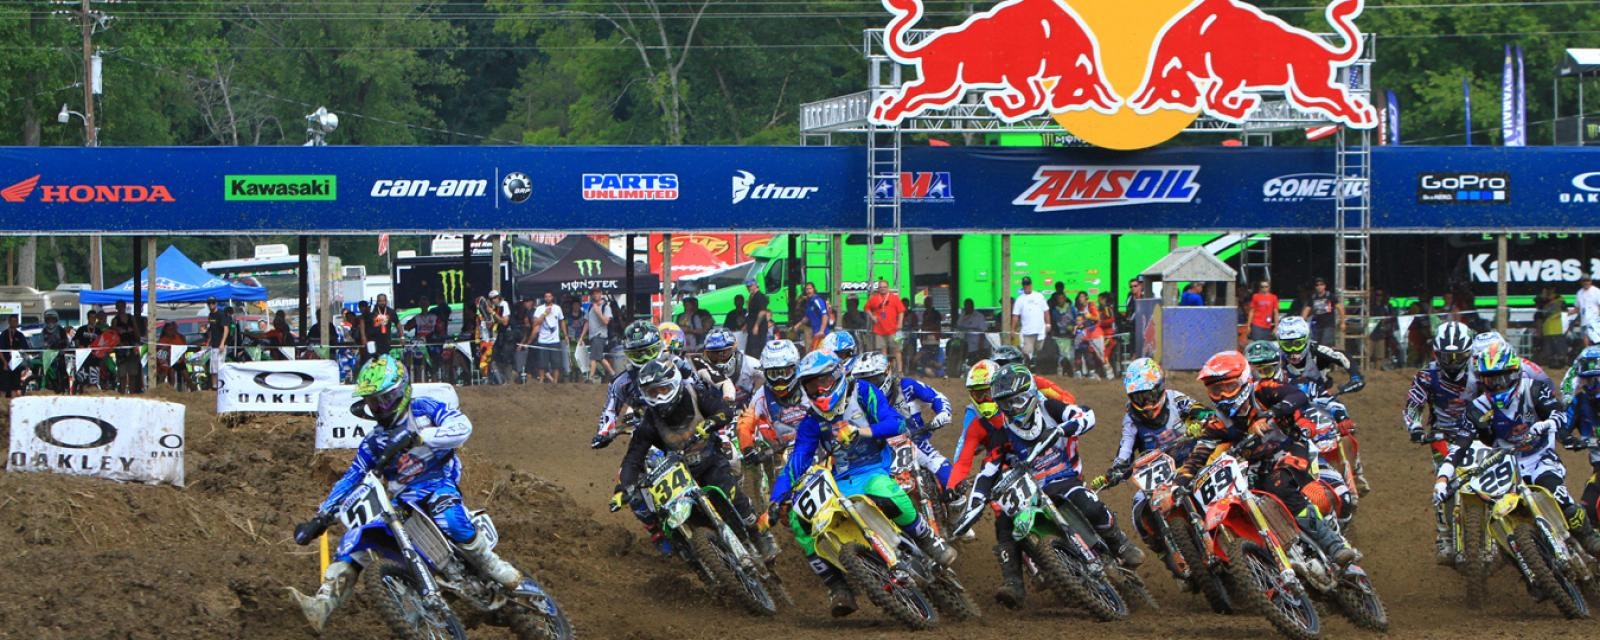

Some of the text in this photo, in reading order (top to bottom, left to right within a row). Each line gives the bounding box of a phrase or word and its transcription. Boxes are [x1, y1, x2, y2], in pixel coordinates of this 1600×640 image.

[1503, 84, 1513, 138] YAMAHA
[231, 179, 330, 196] Kawasaki
[370, 179, 488, 197] can-am
[583, 174, 678, 189] PARTS
[750, 183, 819, 199] thor
[1016, 166, 1199, 210] AMSOIL
[1422, 175, 1506, 189] GoPro
[40, 185, 176, 202] HONDA
[583, 190, 678, 199] UNLIMITED
[1559, 193, 1600, 203] OAK
[1468, 253, 1600, 282] Kawas
[561, 279, 619, 291] MONSTER
[238, 393, 313, 403] OAKLE
[11, 451, 135, 472] OAKLEY
[655, 467, 690, 505] 34
[1139, 460, 1170, 491] 73
[1200, 466, 1233, 505] 69
[1479, 461, 1513, 494] 29
[799, 474, 829, 519] 67
[1001, 475, 1032, 514] 31
[346, 486, 385, 529] 51
